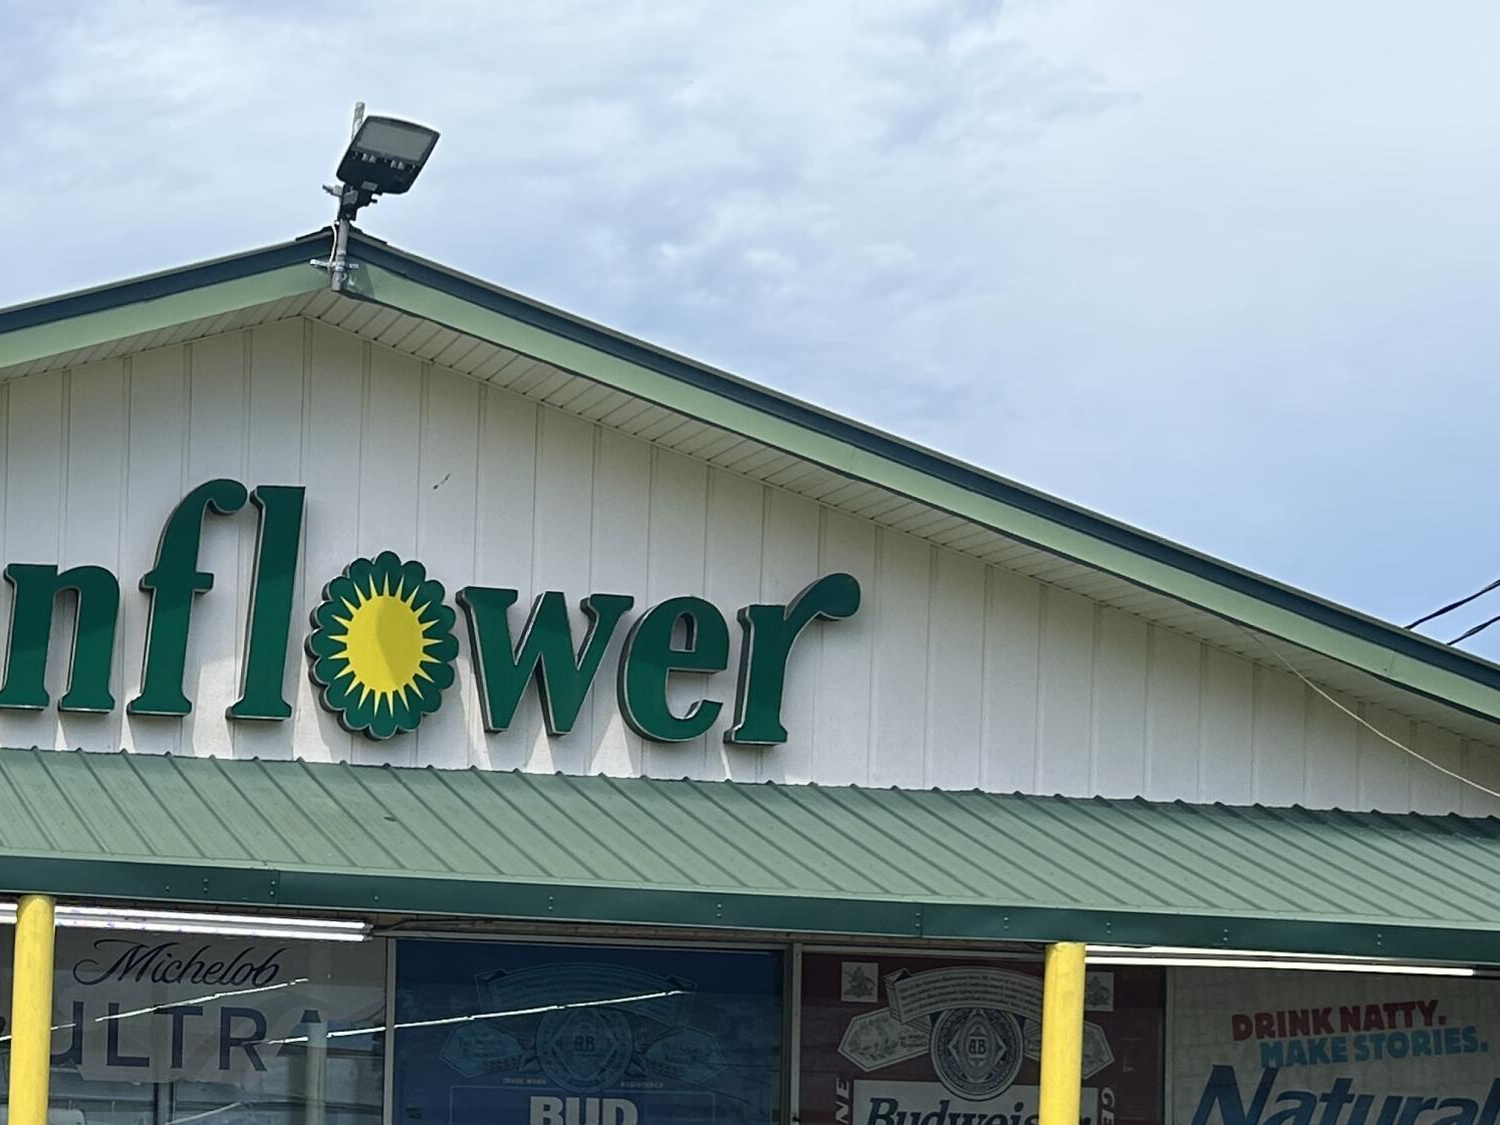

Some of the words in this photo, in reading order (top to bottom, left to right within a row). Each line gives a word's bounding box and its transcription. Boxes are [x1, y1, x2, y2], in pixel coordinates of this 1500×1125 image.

[73, 938, 289, 986] Michelob
[1231, 1007, 1332, 1041] DRINK
[1339, 1000, 1446, 1035] NATTY.
[1260, 1036, 1348, 1068] MAKE
[1352, 1026, 1488, 1062] STORIES.
